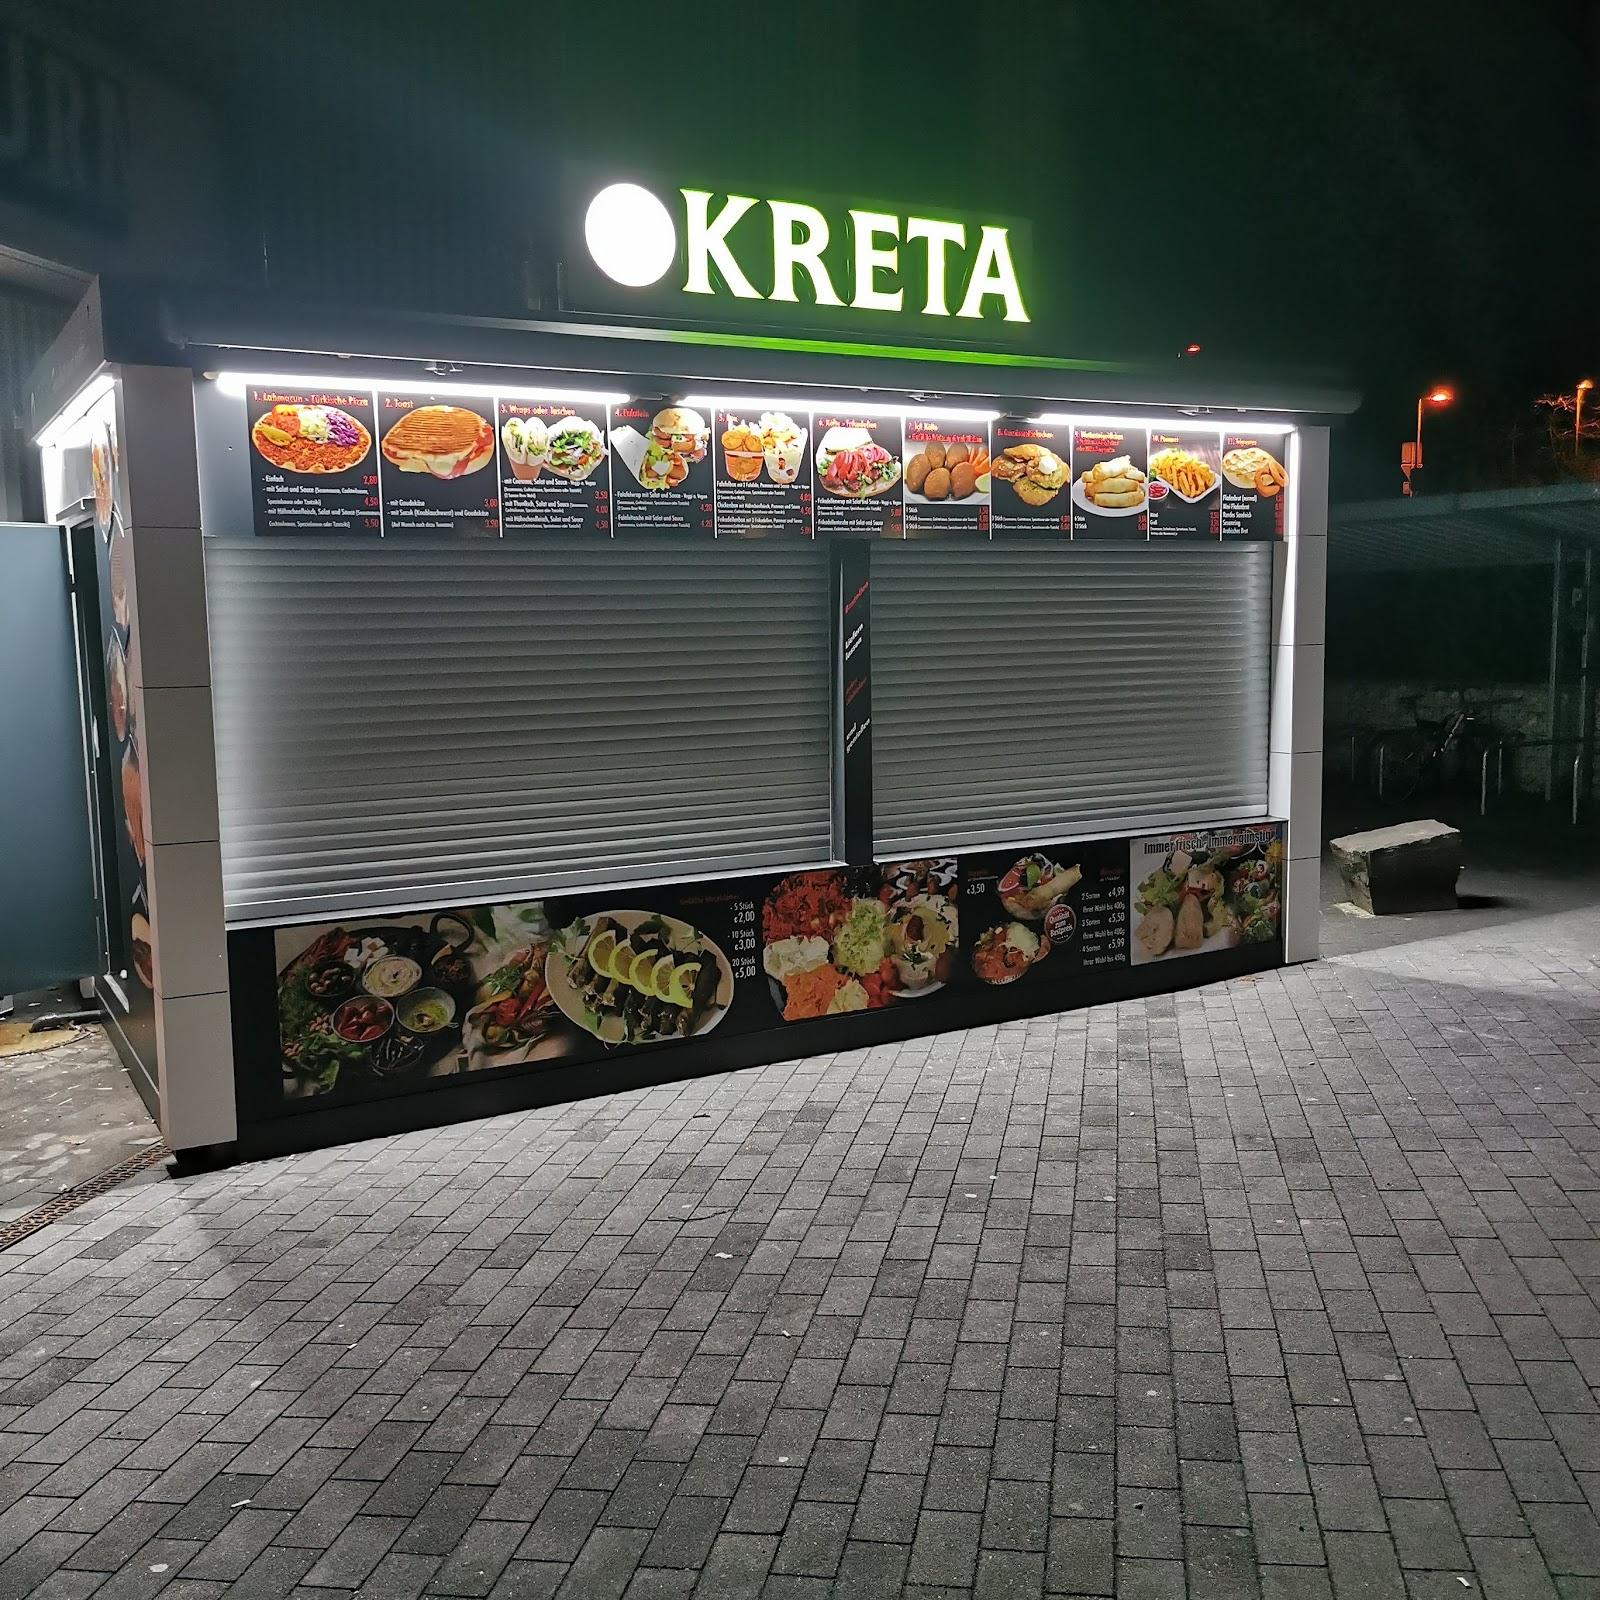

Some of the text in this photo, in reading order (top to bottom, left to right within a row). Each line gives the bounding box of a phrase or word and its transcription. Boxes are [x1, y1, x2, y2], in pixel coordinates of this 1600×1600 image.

[680, 188, 1031, 323] KRETA
[348, 395, 369, 406] Pizza
[394, 398, 414, 408] Toast
[1144, 842, 1174, 855] Immer
[1175, 838, 1203, 851] frisch
[1208, 834, 1236, 848] Immer
[739, 901, 754, 911] Stück
[732, 928, 755, 939] 10 Stück
[732, 956, 756, 967] 20 Stück
